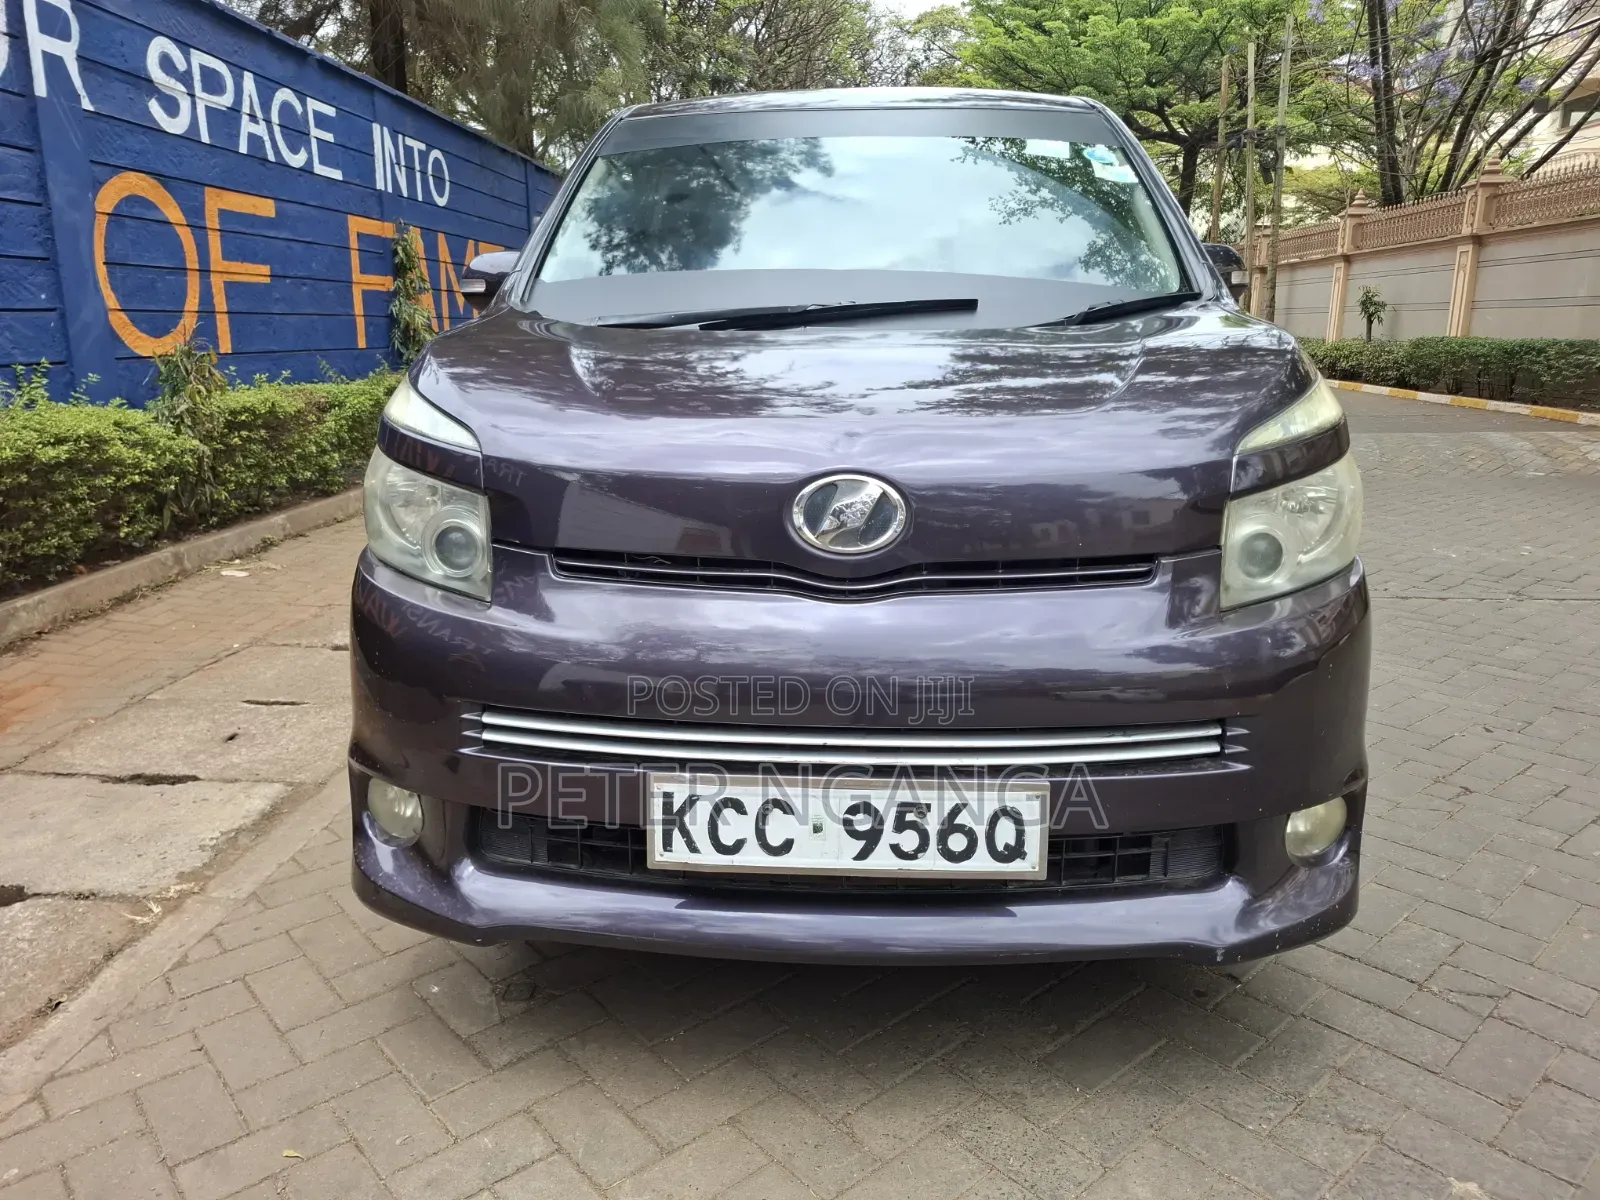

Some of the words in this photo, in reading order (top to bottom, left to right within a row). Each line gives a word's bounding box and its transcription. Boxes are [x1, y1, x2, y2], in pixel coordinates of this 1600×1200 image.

[0, 0, 95, 111] R
[146, 36, 343, 181] SPACE
[372, 122, 451, 207] INTO
[94, 170, 276, 357] OF
[347, 214, 506, 349] FAM
[661, 791, 796, 857] KCC
[842, 799, 1028, 864] 956Q
